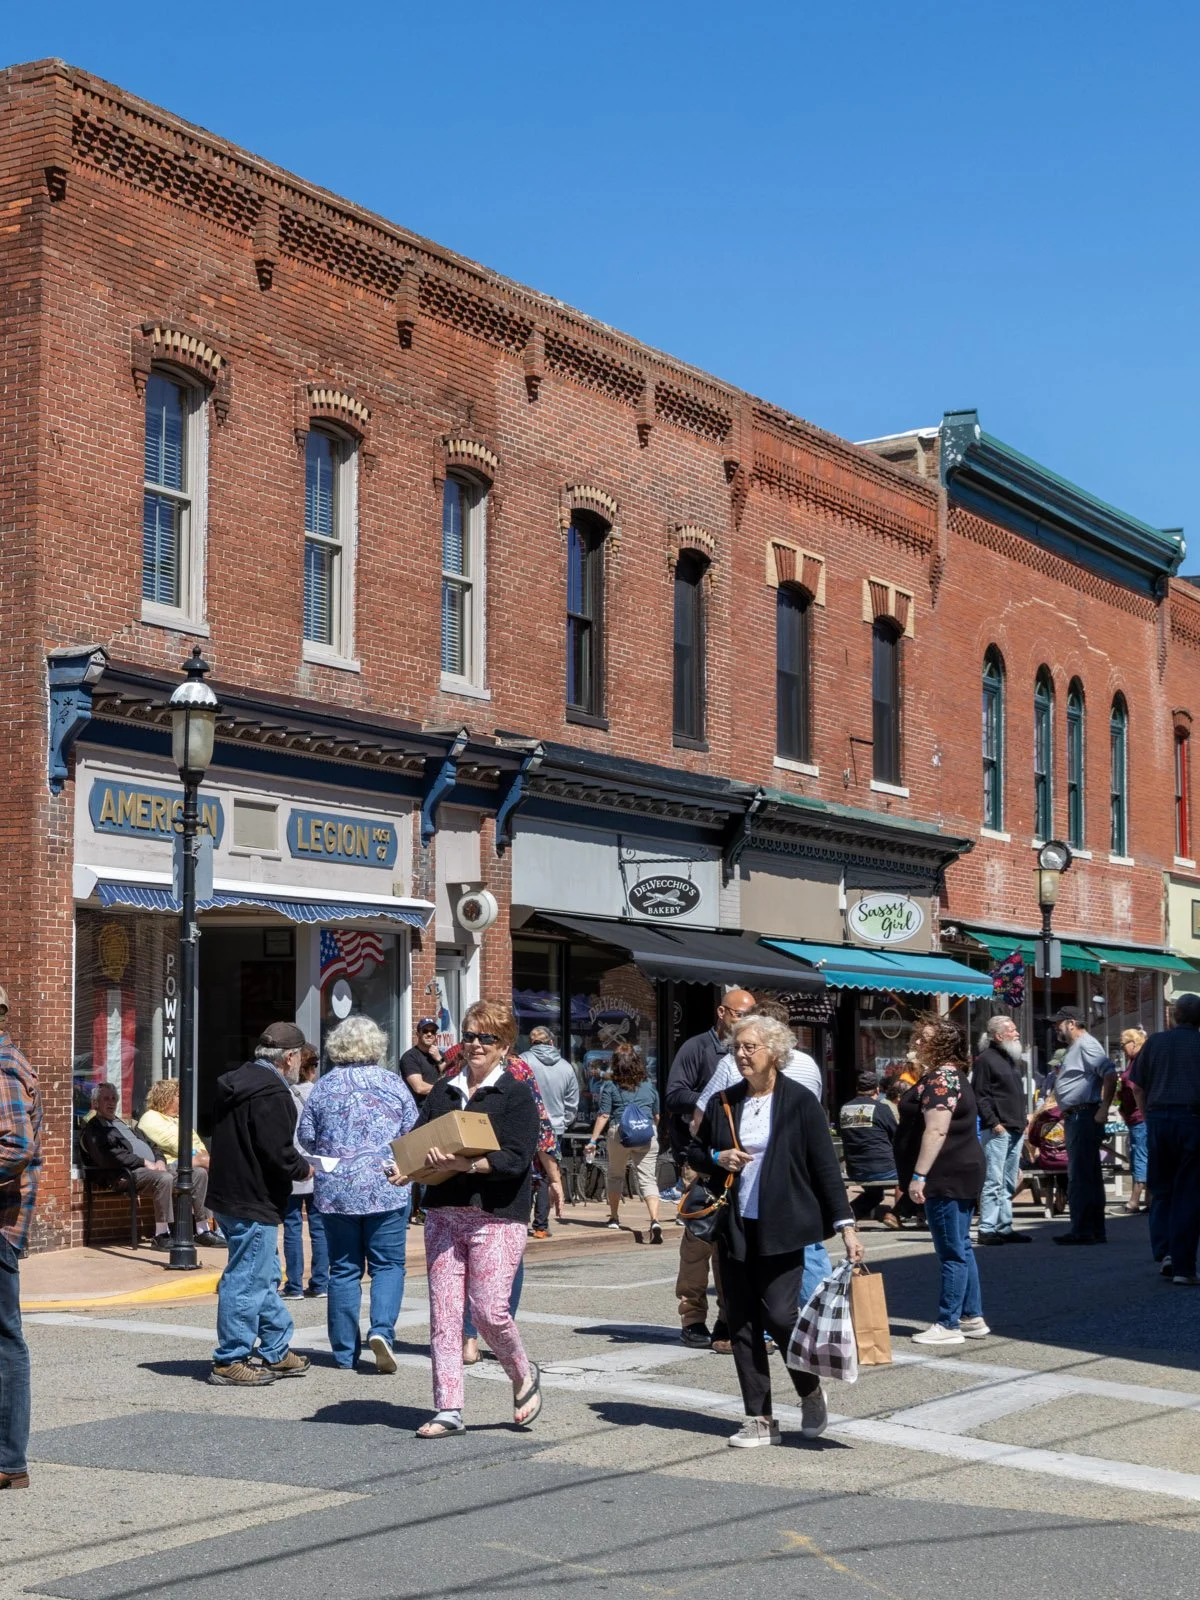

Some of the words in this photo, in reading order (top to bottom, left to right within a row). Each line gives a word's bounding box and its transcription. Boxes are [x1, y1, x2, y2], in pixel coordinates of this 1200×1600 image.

[100, 788, 217, 838] AMERICN
[297, 817, 368, 857] LEGION
[647, 906, 681, 915] BAKERY
[858, 902, 907, 922] Sassy
[881, 911, 916, 939] Girl
